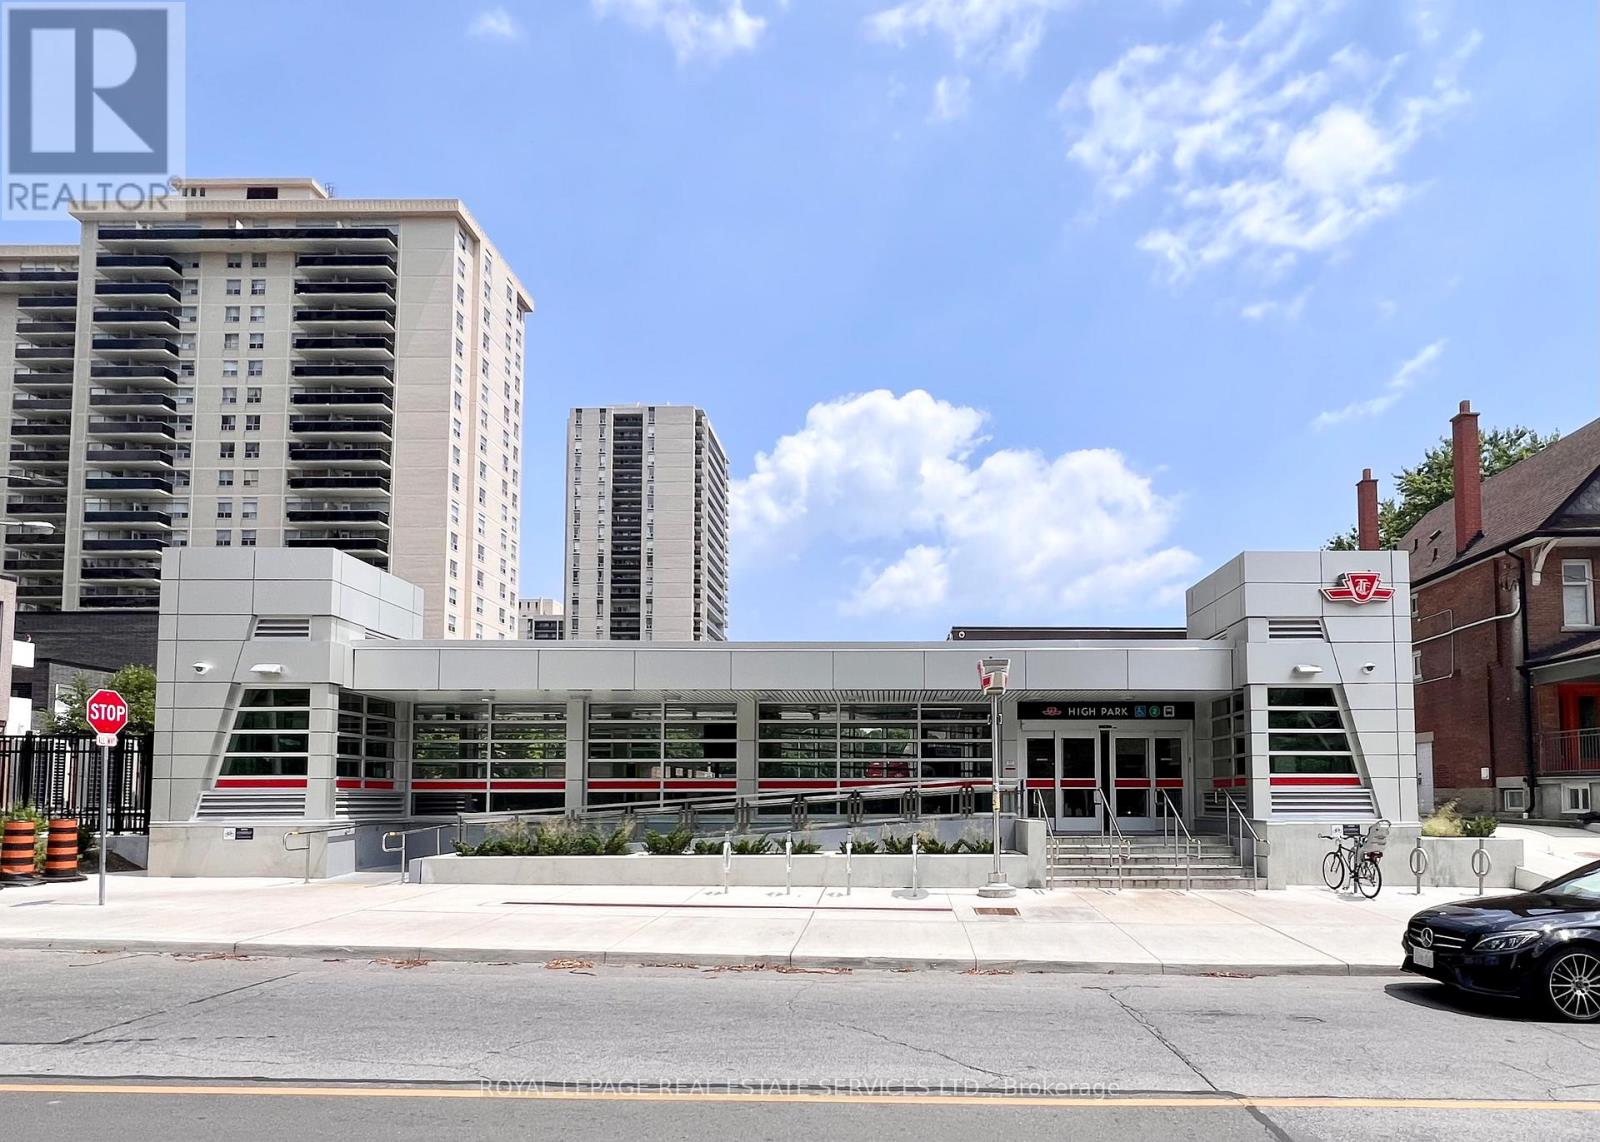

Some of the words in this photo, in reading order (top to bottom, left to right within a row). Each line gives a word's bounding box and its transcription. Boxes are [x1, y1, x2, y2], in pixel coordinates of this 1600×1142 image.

[90, 703, 126, 722] STOP
[1068, 707, 1096, 716] HIGH
[1101, 707, 1128, 716] PARK
